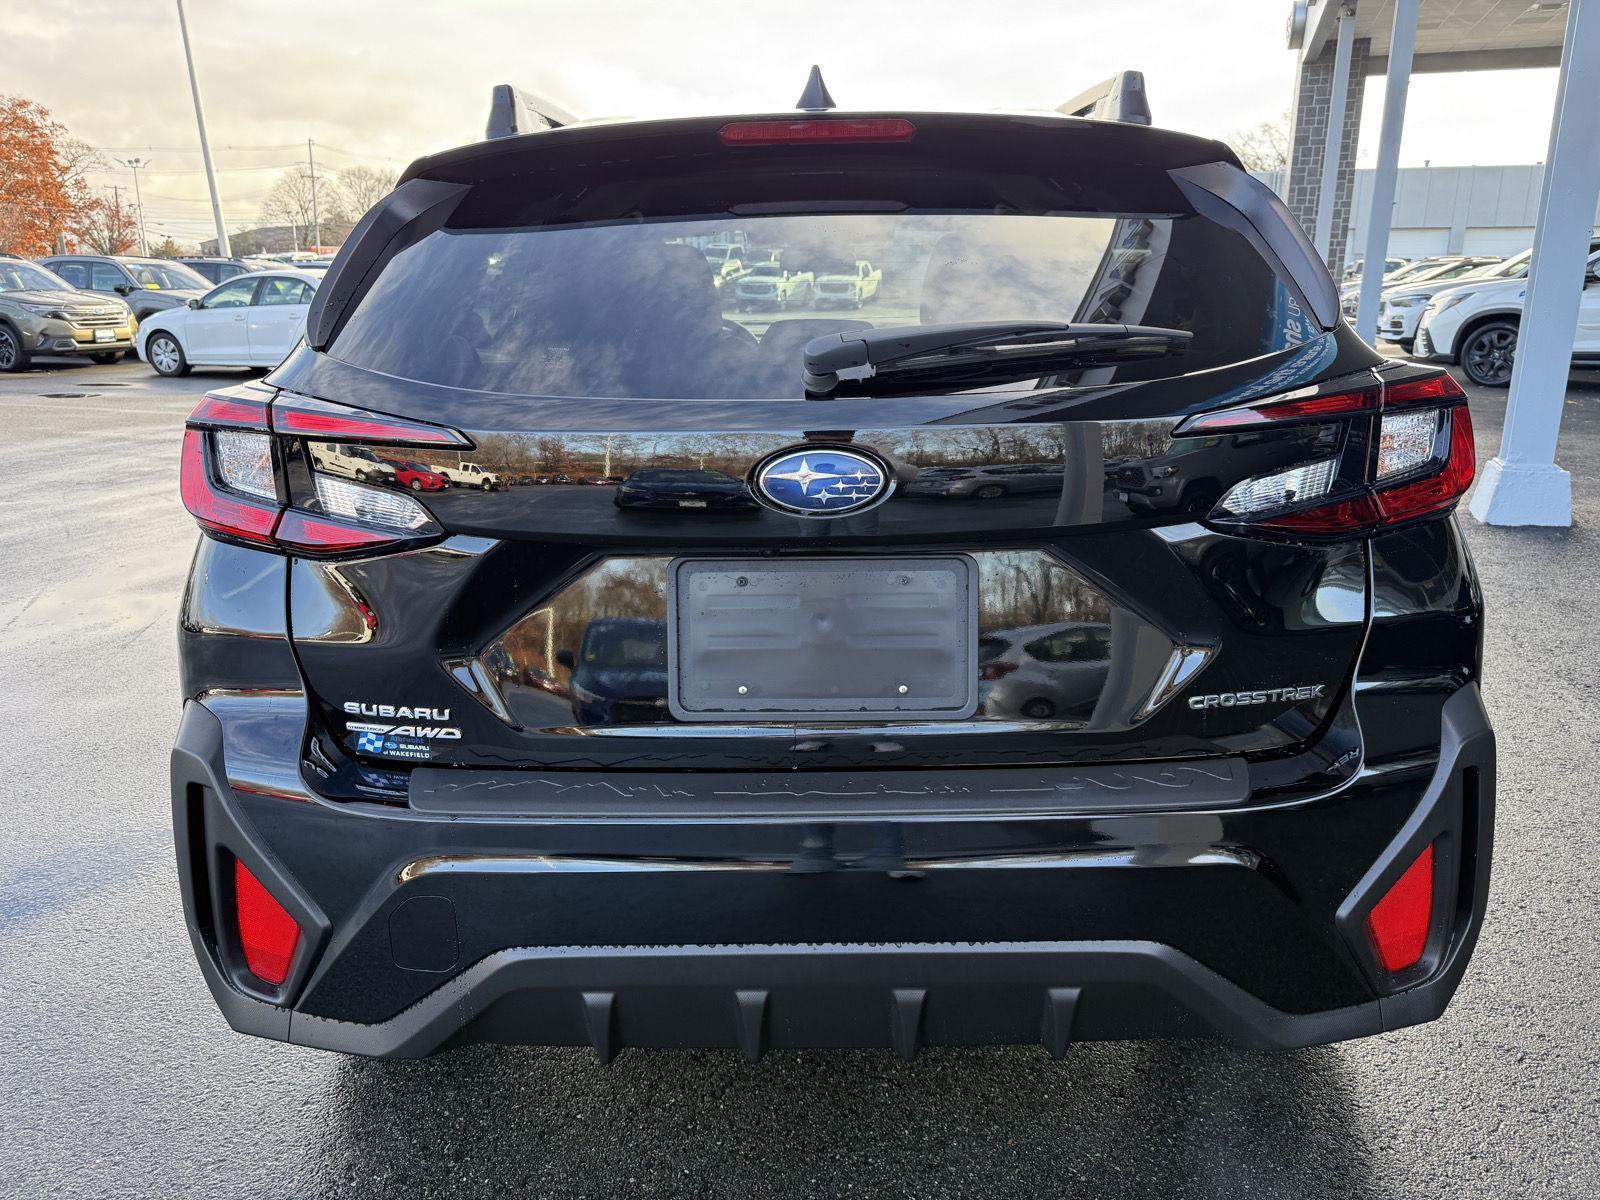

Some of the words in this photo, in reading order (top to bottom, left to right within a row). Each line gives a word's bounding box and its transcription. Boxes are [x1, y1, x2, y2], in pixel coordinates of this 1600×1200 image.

[1188, 685, 1326, 709] CROSSTREK
[343, 701, 450, 720] SUBARU
[389, 725, 462, 739] AWD
[399, 743, 430, 751] SUBARU
[390, 750, 430, 759] WAKEFIELD
